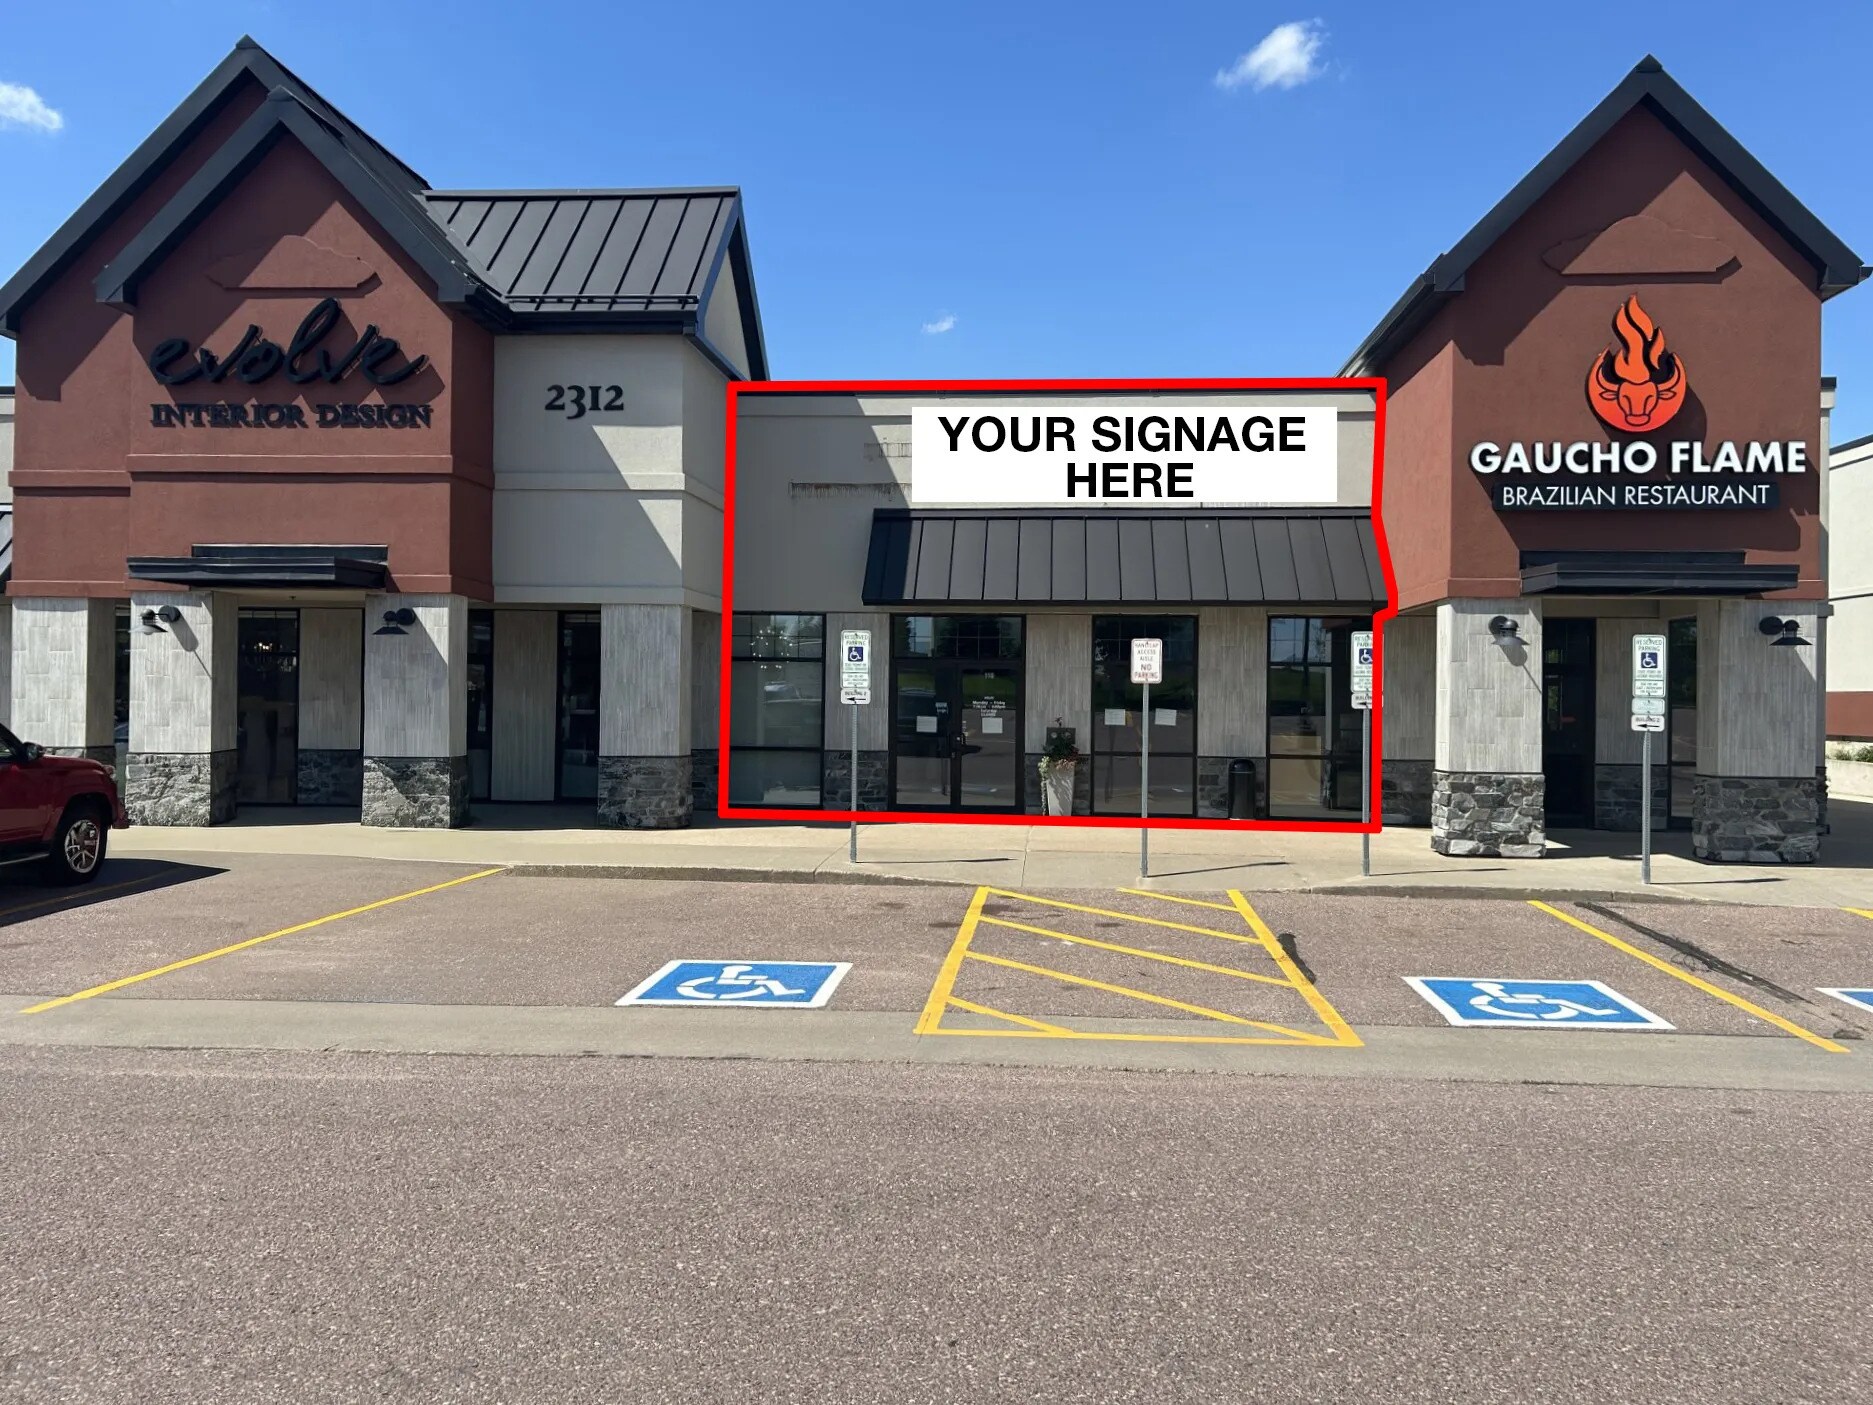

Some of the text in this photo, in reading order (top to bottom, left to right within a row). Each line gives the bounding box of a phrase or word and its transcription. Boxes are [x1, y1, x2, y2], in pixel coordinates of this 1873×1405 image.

[151, 298, 429, 385] evolve
[150, 404, 433, 428] INTERIOR DESIGN
[544, 384, 624, 420] 2312
[1470, 441, 1806, 475] GAUCHO FLAME
[1503, 484, 1770, 506] BRAZILIAN RESTAURANT
